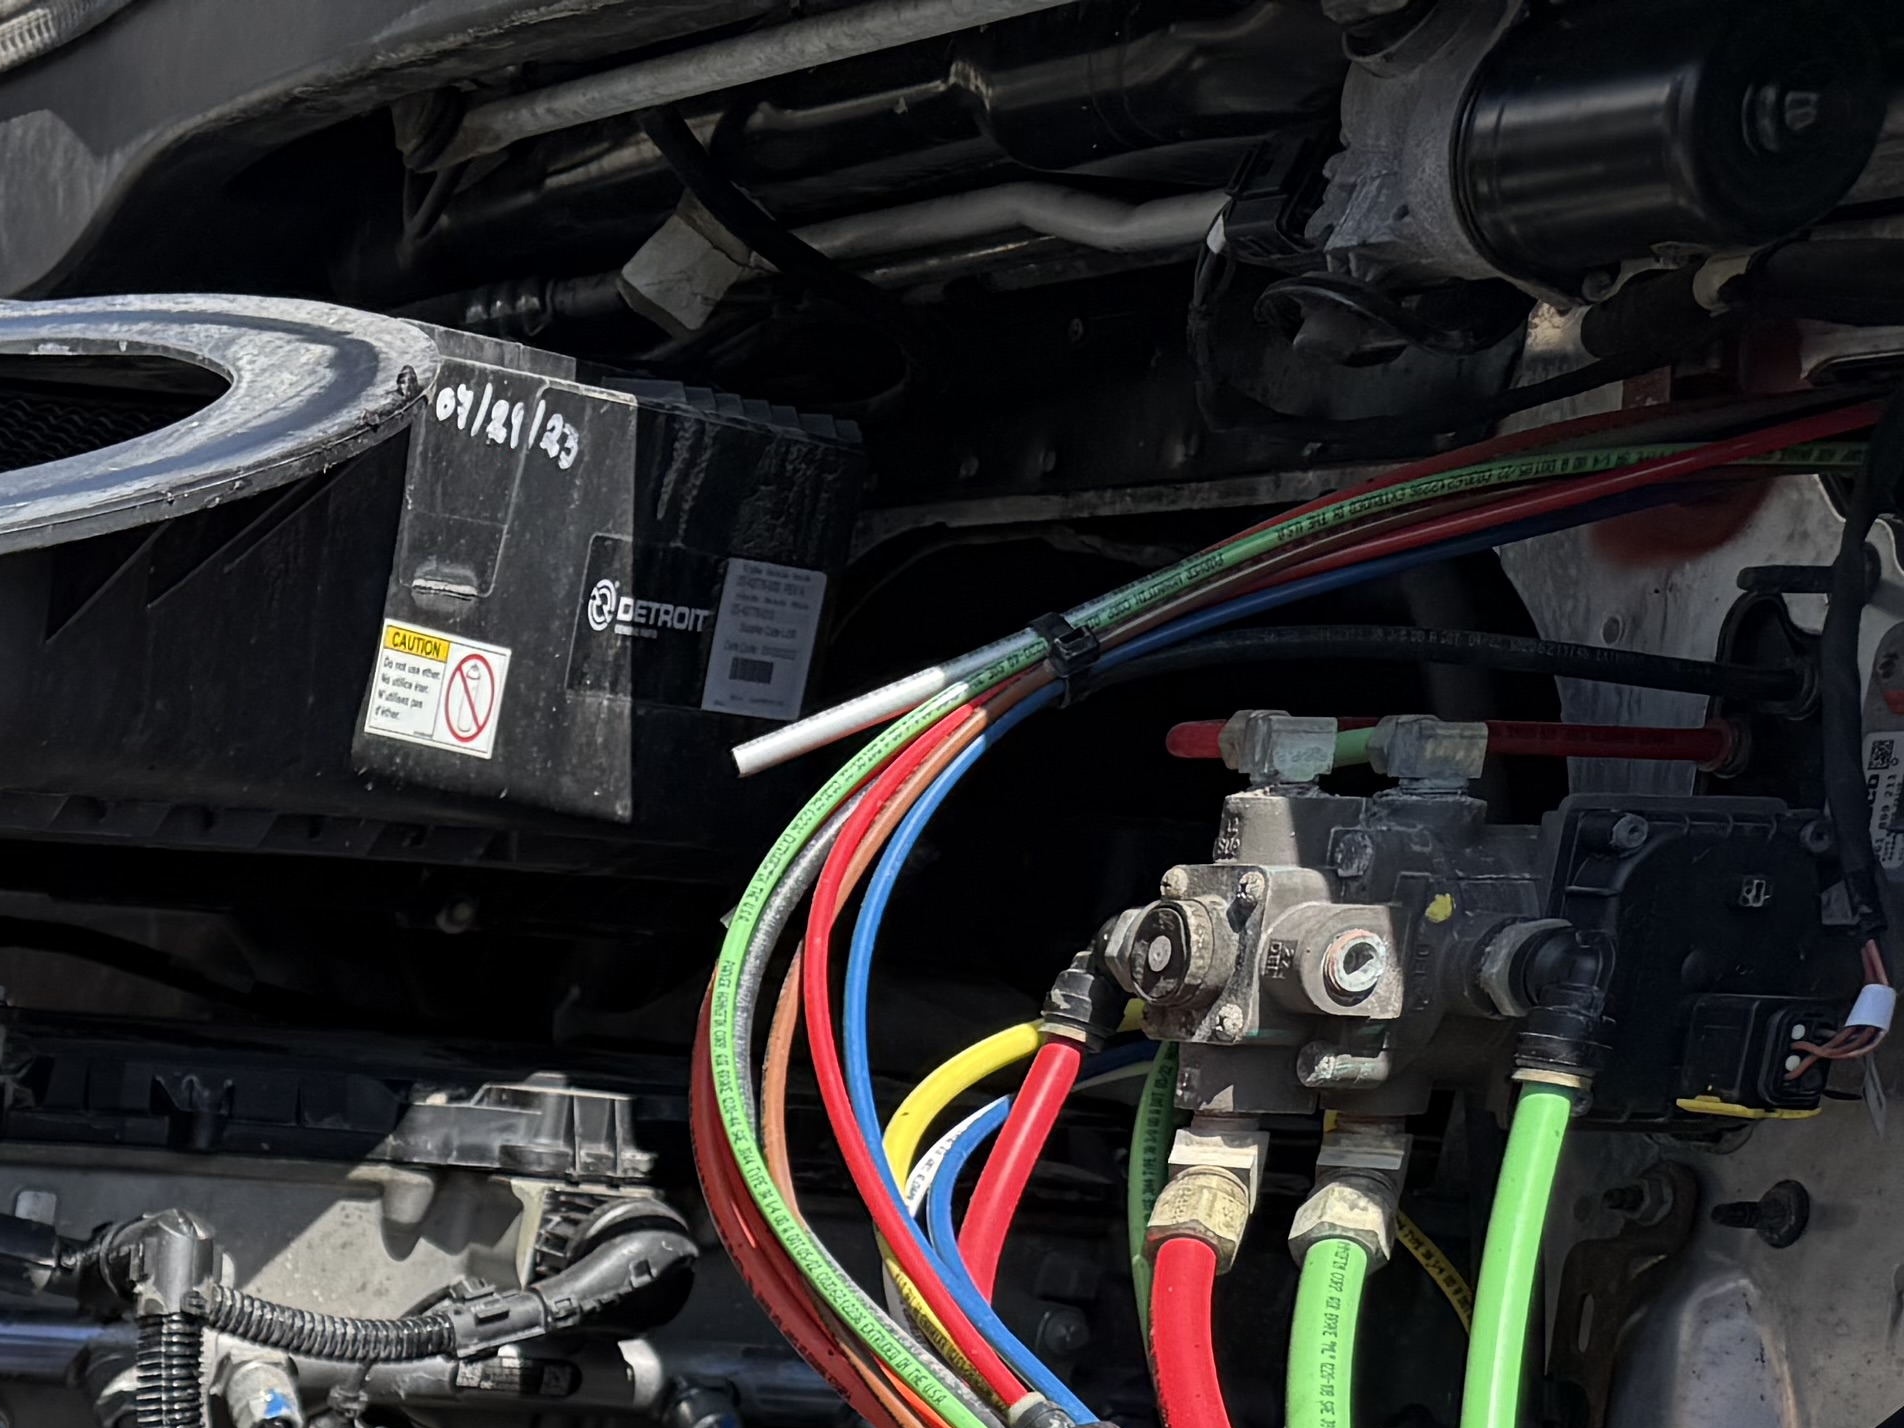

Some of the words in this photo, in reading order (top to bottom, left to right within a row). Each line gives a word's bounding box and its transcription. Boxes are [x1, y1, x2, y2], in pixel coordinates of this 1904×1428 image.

[616, 596, 709, 632] DETROIT
[392, 632, 441, 658] CAUTION
[395, 661, 407, 671] not
[860, 1322, 897, 1361] EXTRUDED
[908, 1364, 928, 1386] THE
